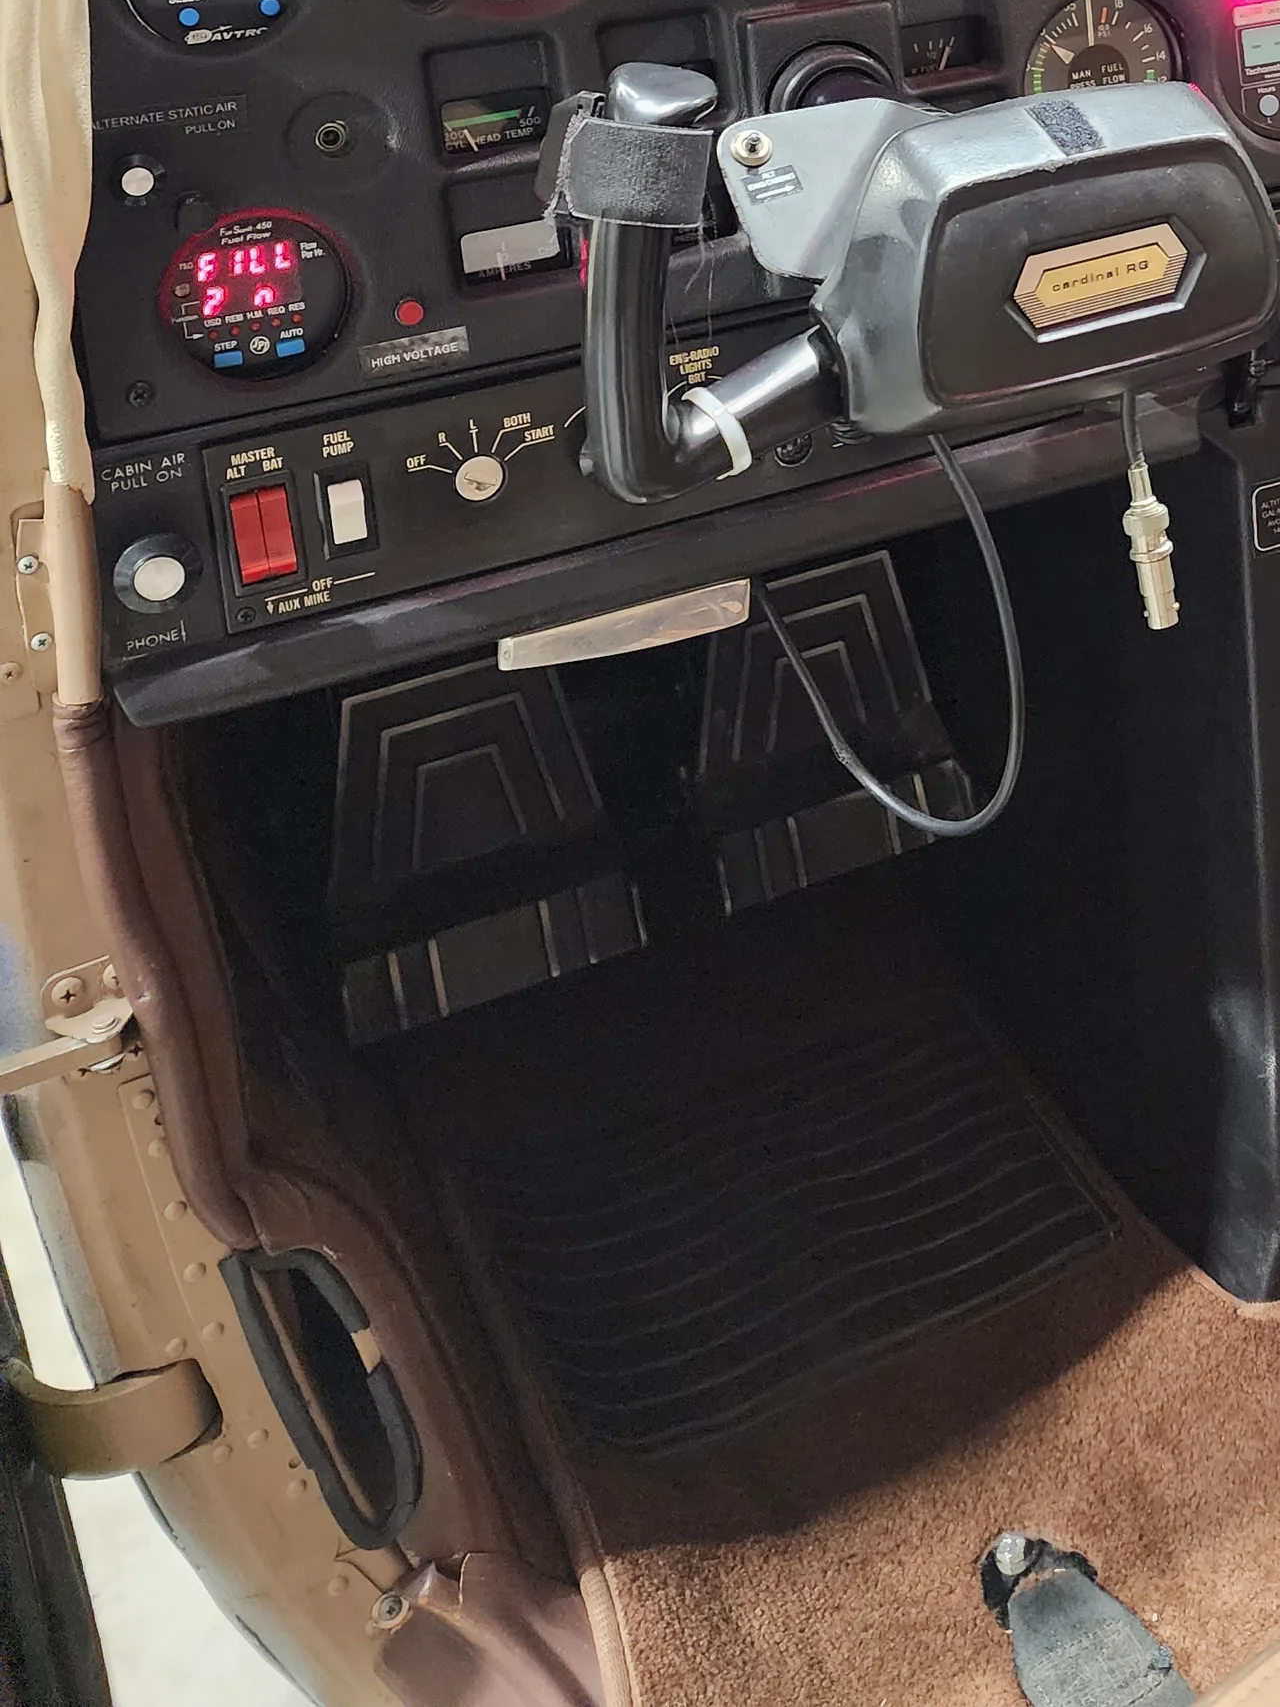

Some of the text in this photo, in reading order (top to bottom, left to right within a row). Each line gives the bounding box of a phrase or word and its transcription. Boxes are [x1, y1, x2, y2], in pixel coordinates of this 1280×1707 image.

[1143, 23, 1153, 34] 16
[1156, 50, 1166, 61] 14
[1072, 69, 1092, 80] MAN
[1101, 62, 1124, 74] FUEL
[1102, 74, 1126, 85] FLOW
[168, 105, 214, 120] STATIC
[215, 101, 238, 113] AIR
[184, 119, 236, 135] PULL ON
[519, 116, 542, 128] 500
[472, 127, 534, 145] HEAD TEMP
[256, 221, 273, 231] 450
[221, 235, 244, 245] Fuel
[246, 231, 272, 241] Flow
[1052, 260, 1149, 292] cardinal RG
[280, 328, 304, 339] AUTO
[214, 340, 238, 351] STEP
[371, 341, 459, 369] HIGH VOLTAGE
[679, 358, 713, 375] LIGHTS
[469, 419, 477, 430] L
[503, 412, 531, 429] BOTH
[322, 430, 351, 445] FUEL
[438, 432, 447, 444] R
[524, 425, 556, 442] START
[230, 446, 276, 466] MASTER
[322, 441, 354, 458] PUMP
[101, 452, 186, 482] CABIN AIR
[262, 456, 284, 472] BAT
[406, 455, 427, 469] OFF
[111, 467, 182, 493] PULL ON
[226, 466, 247, 480] ALT
[311, 577, 334, 592] OFF
[278, 591, 331, 614] AUX MIKE
[126, 628, 181, 651] PHONE
